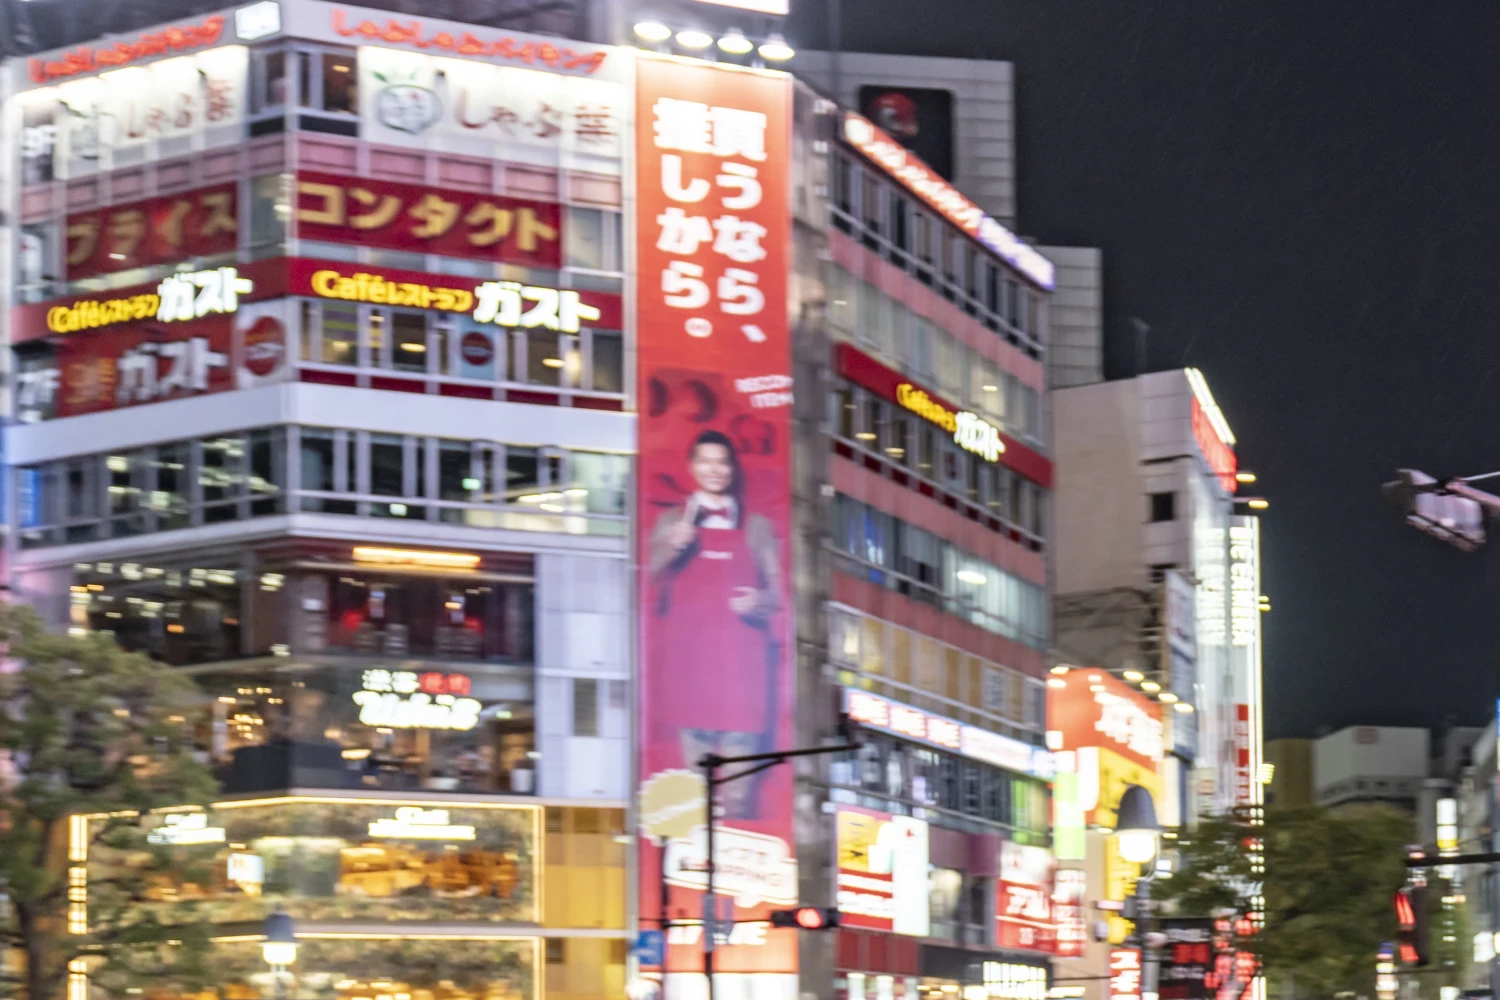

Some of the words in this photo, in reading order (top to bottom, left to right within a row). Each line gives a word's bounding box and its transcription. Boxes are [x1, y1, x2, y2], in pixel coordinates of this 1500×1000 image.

[455, 86, 615, 143] しゃぶ葉
[297, 180, 558, 252] コンタクト
[156, 266, 253, 323] ガスト
[472, 280, 601, 333] ガスト
